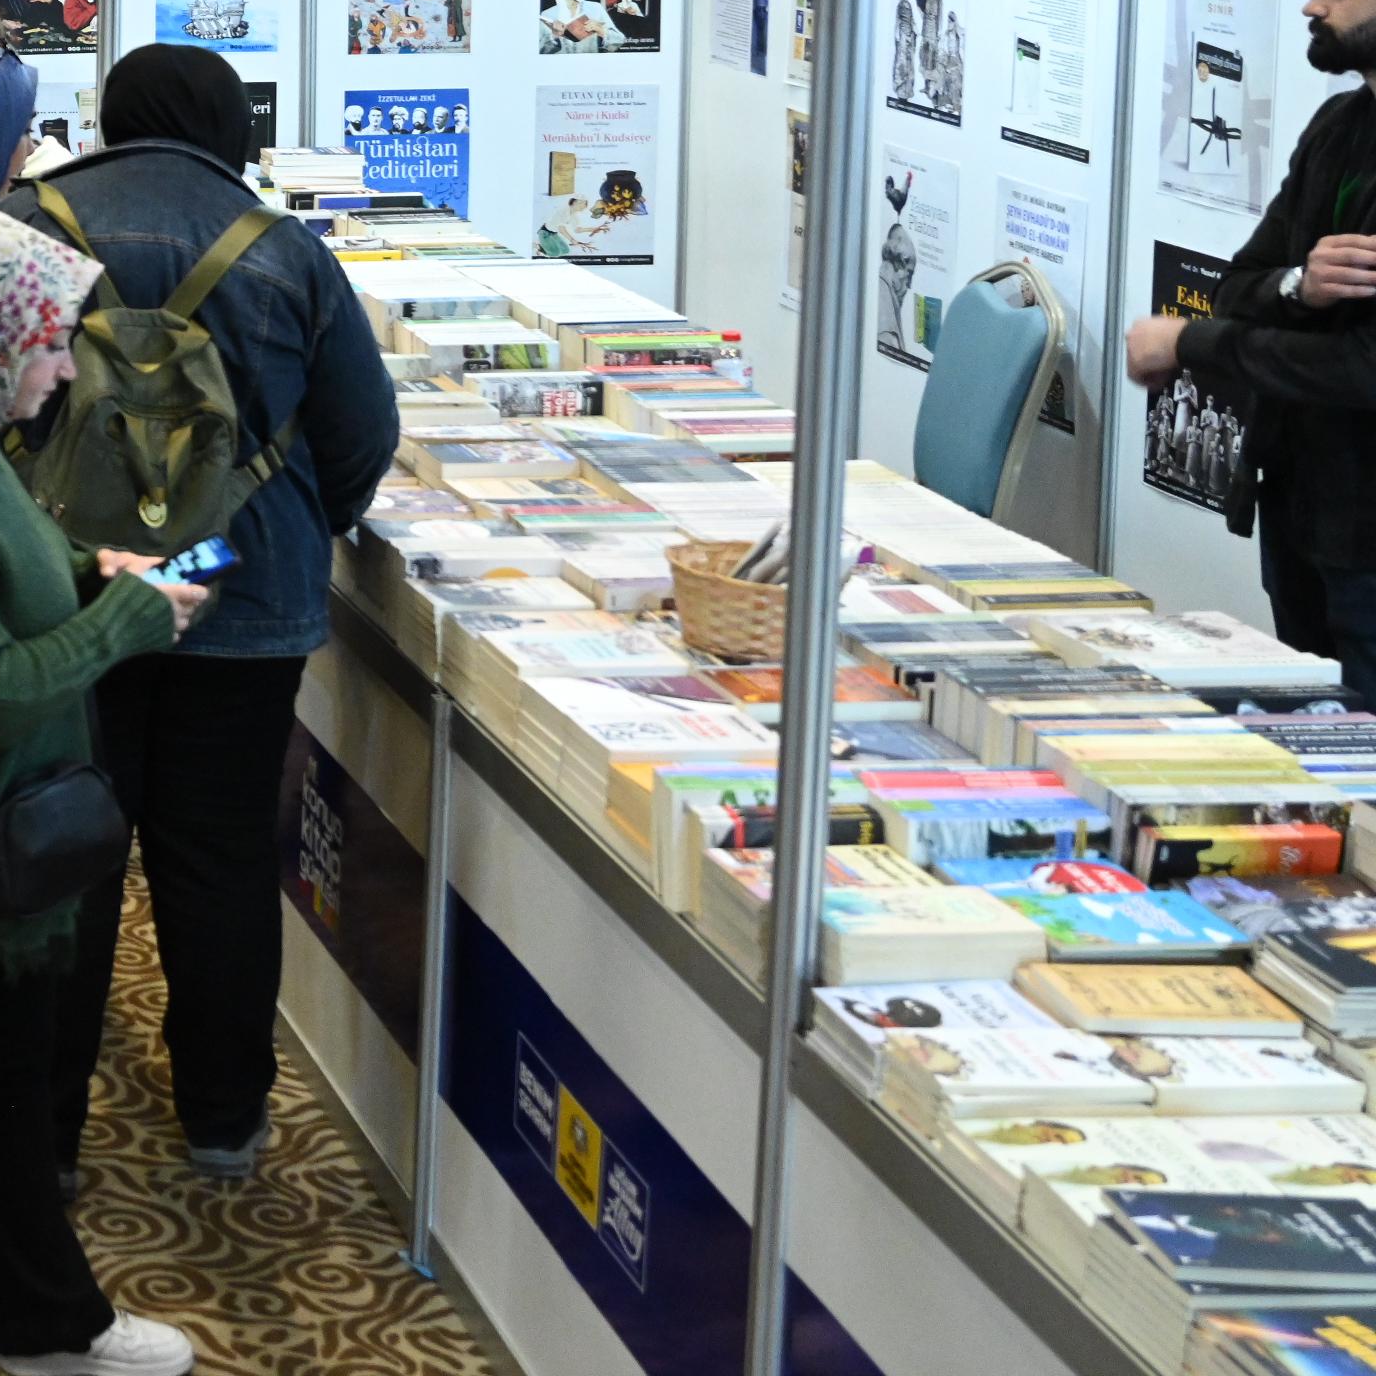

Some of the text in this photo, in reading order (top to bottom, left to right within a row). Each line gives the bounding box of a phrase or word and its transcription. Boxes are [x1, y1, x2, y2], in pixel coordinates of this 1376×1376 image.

[561, 90, 635, 101] ELVAN ÇELEBİ
[355, 137, 459, 158] Türkistan
